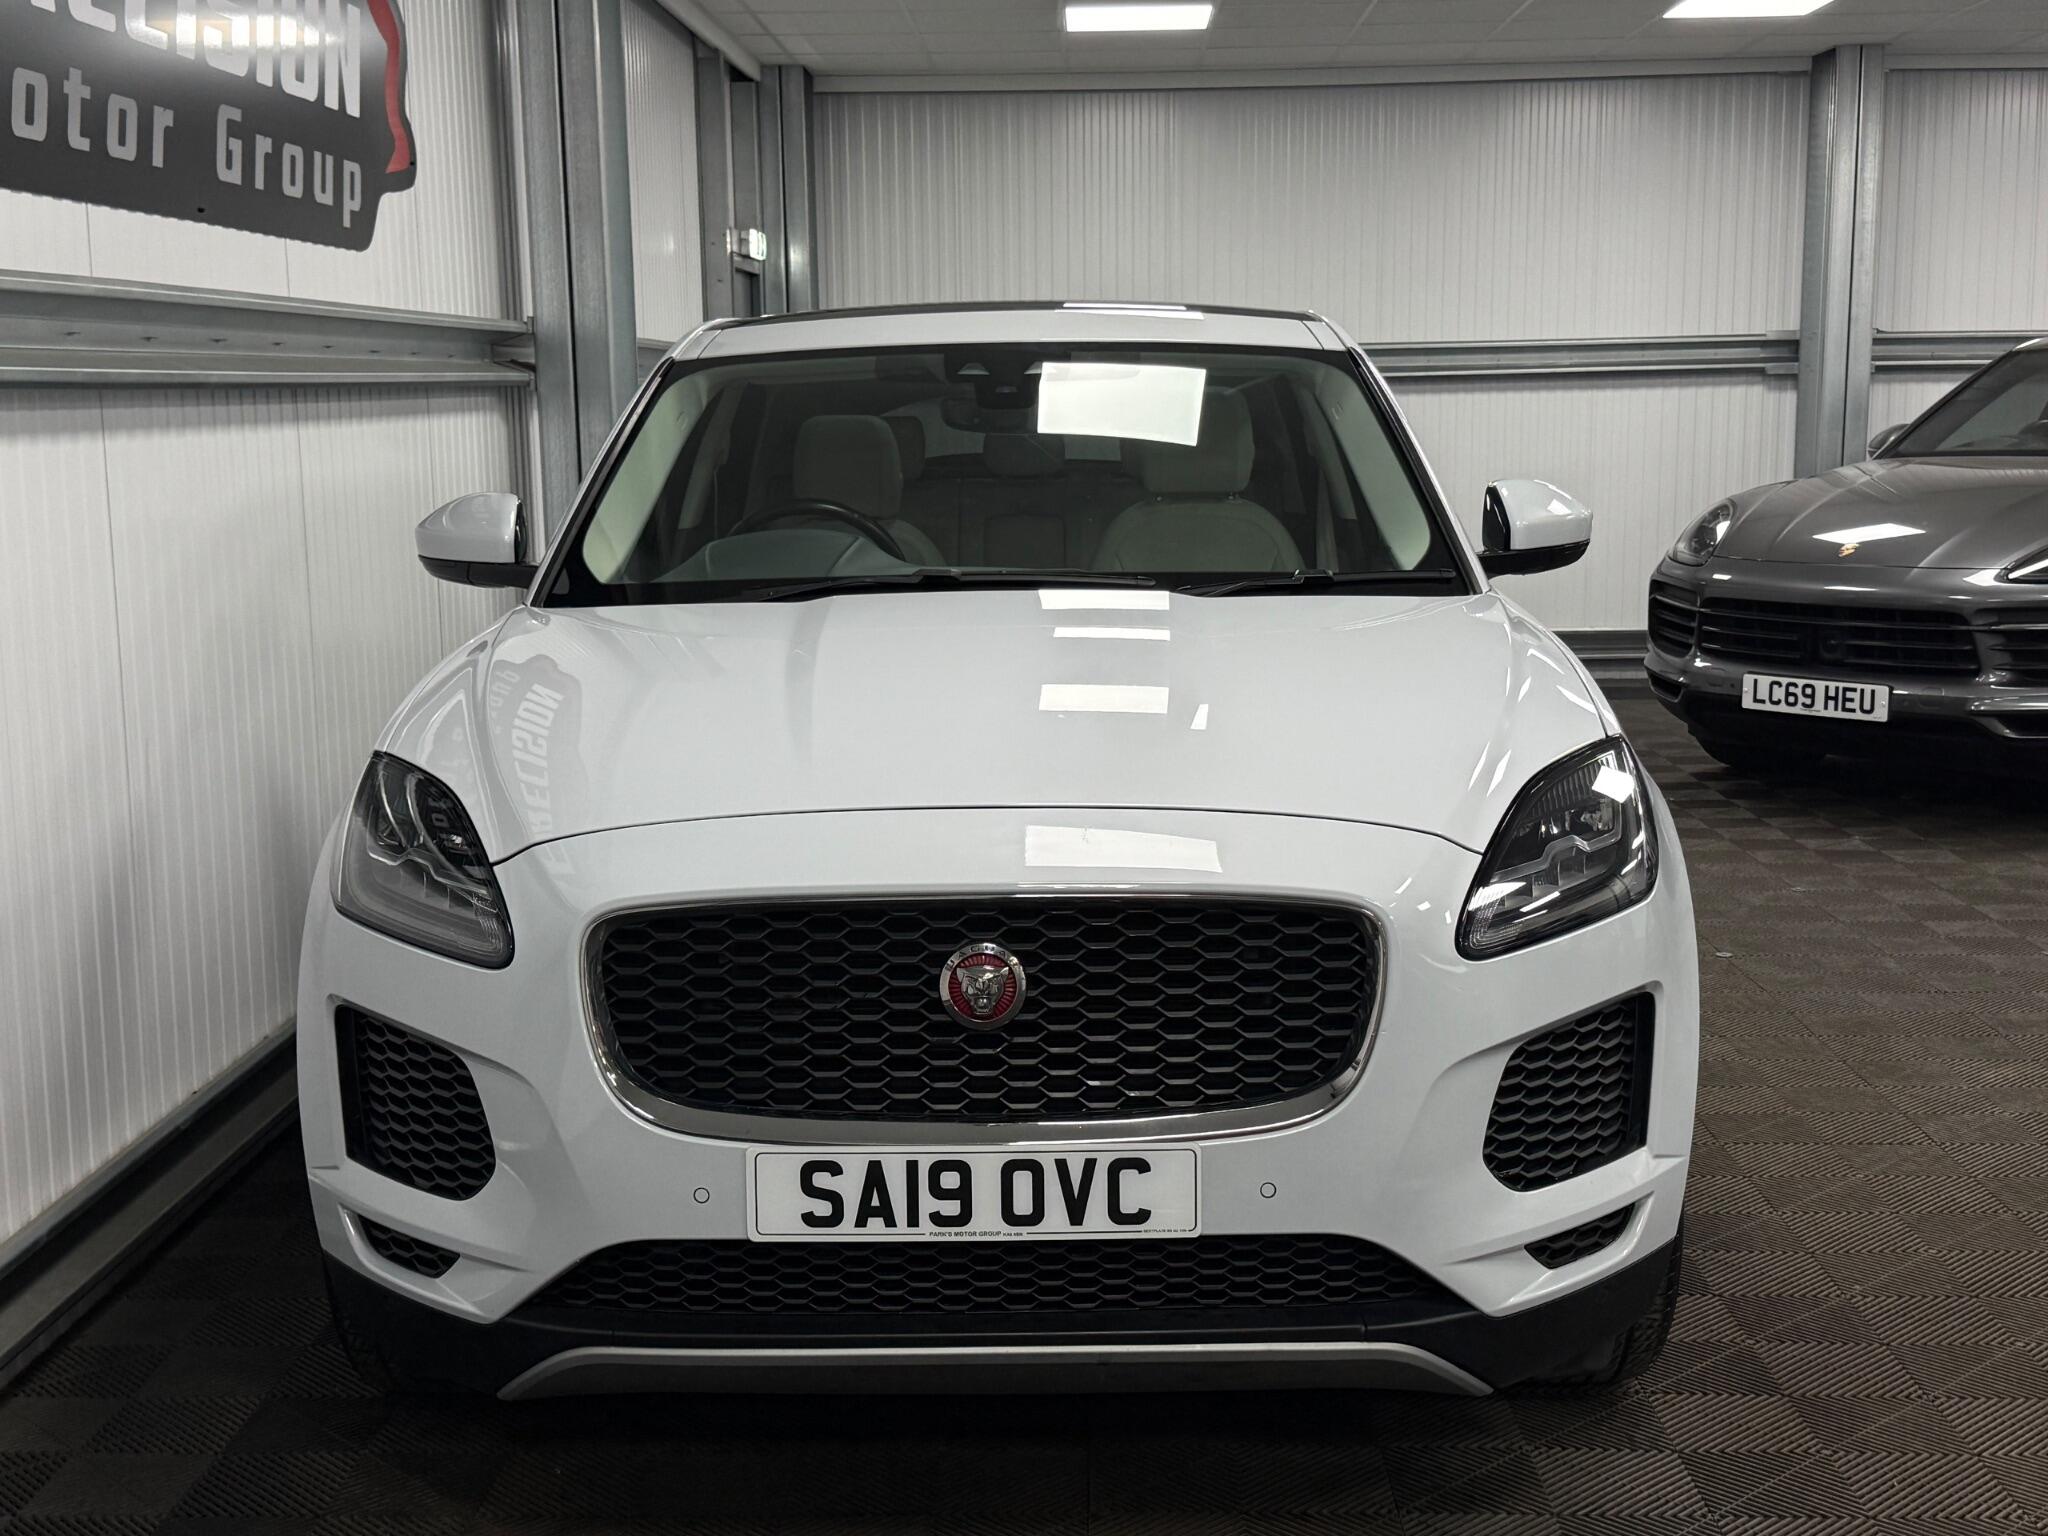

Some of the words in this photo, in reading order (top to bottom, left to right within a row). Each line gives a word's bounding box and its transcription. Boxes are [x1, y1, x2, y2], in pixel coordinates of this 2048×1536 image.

[216, 104, 362, 228] Group
[1752, 678, 1816, 709] LC69
[1823, 685, 1876, 715] HEU
[800, 1159, 973, 1228] SA19
[1000, 1157, 1152, 1227] OVC
